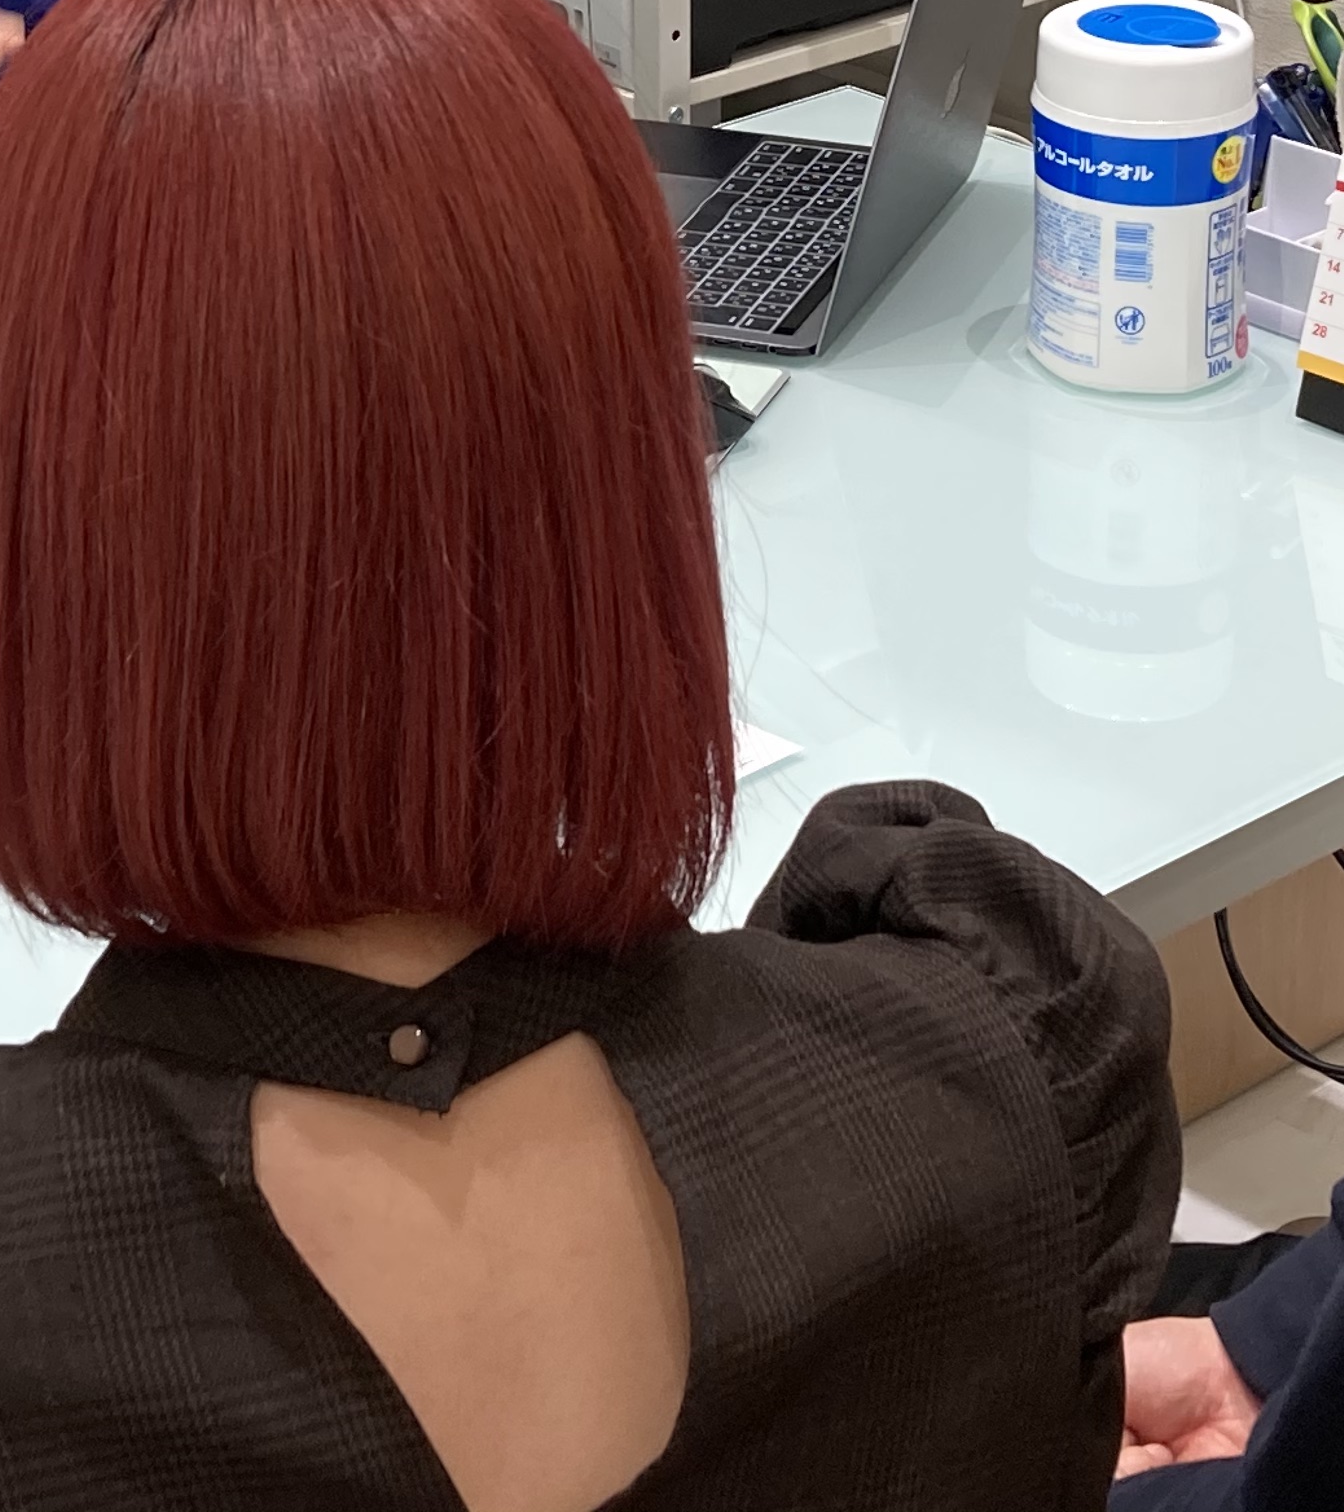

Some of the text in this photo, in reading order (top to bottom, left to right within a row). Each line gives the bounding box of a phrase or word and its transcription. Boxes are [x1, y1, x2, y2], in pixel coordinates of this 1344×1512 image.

[1036, 136, 1154, 182] アルコールタオル
[1337, 228, 1344, 240] 7
[1327, 259, 1341, 273] 14
[1319, 291, 1334, 306] 21
[1311, 323, 1328, 339] 28
